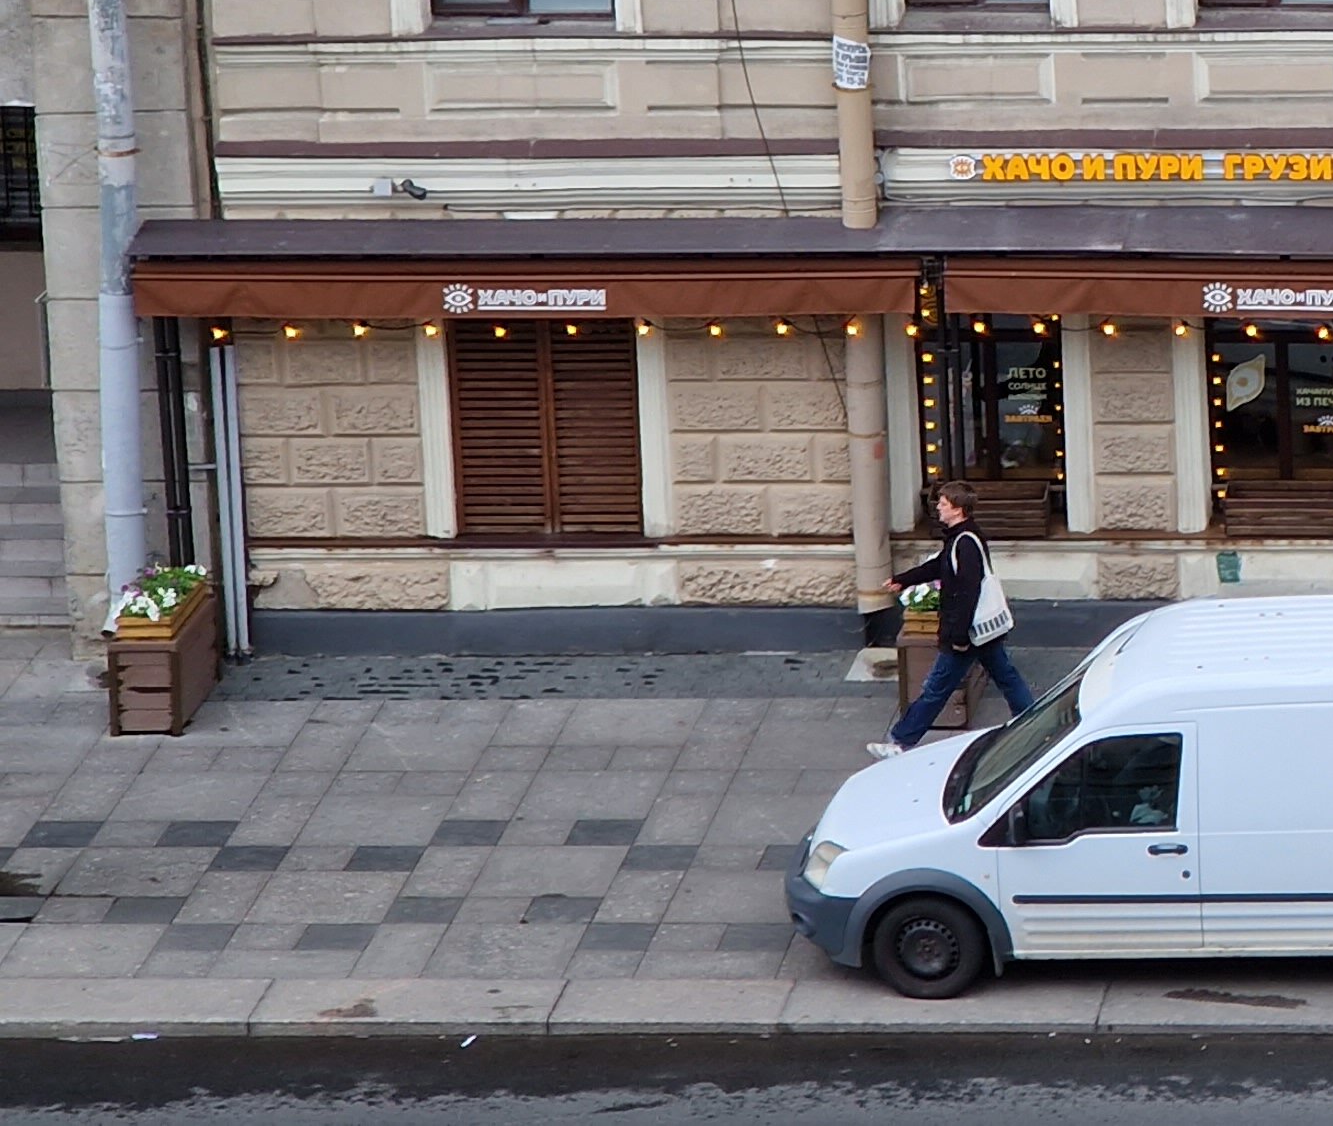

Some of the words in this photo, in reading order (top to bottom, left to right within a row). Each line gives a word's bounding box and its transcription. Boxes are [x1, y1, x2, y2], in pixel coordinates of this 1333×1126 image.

[982, 153, 1077, 181] ХАЧО
[1082, 153, 1106, 181] И
[1113, 153, 1204, 181] ПУРИ
[1007, 367, 1047, 379] ЛЕТО
[1296, 397, 1311, 406] ИЗ
